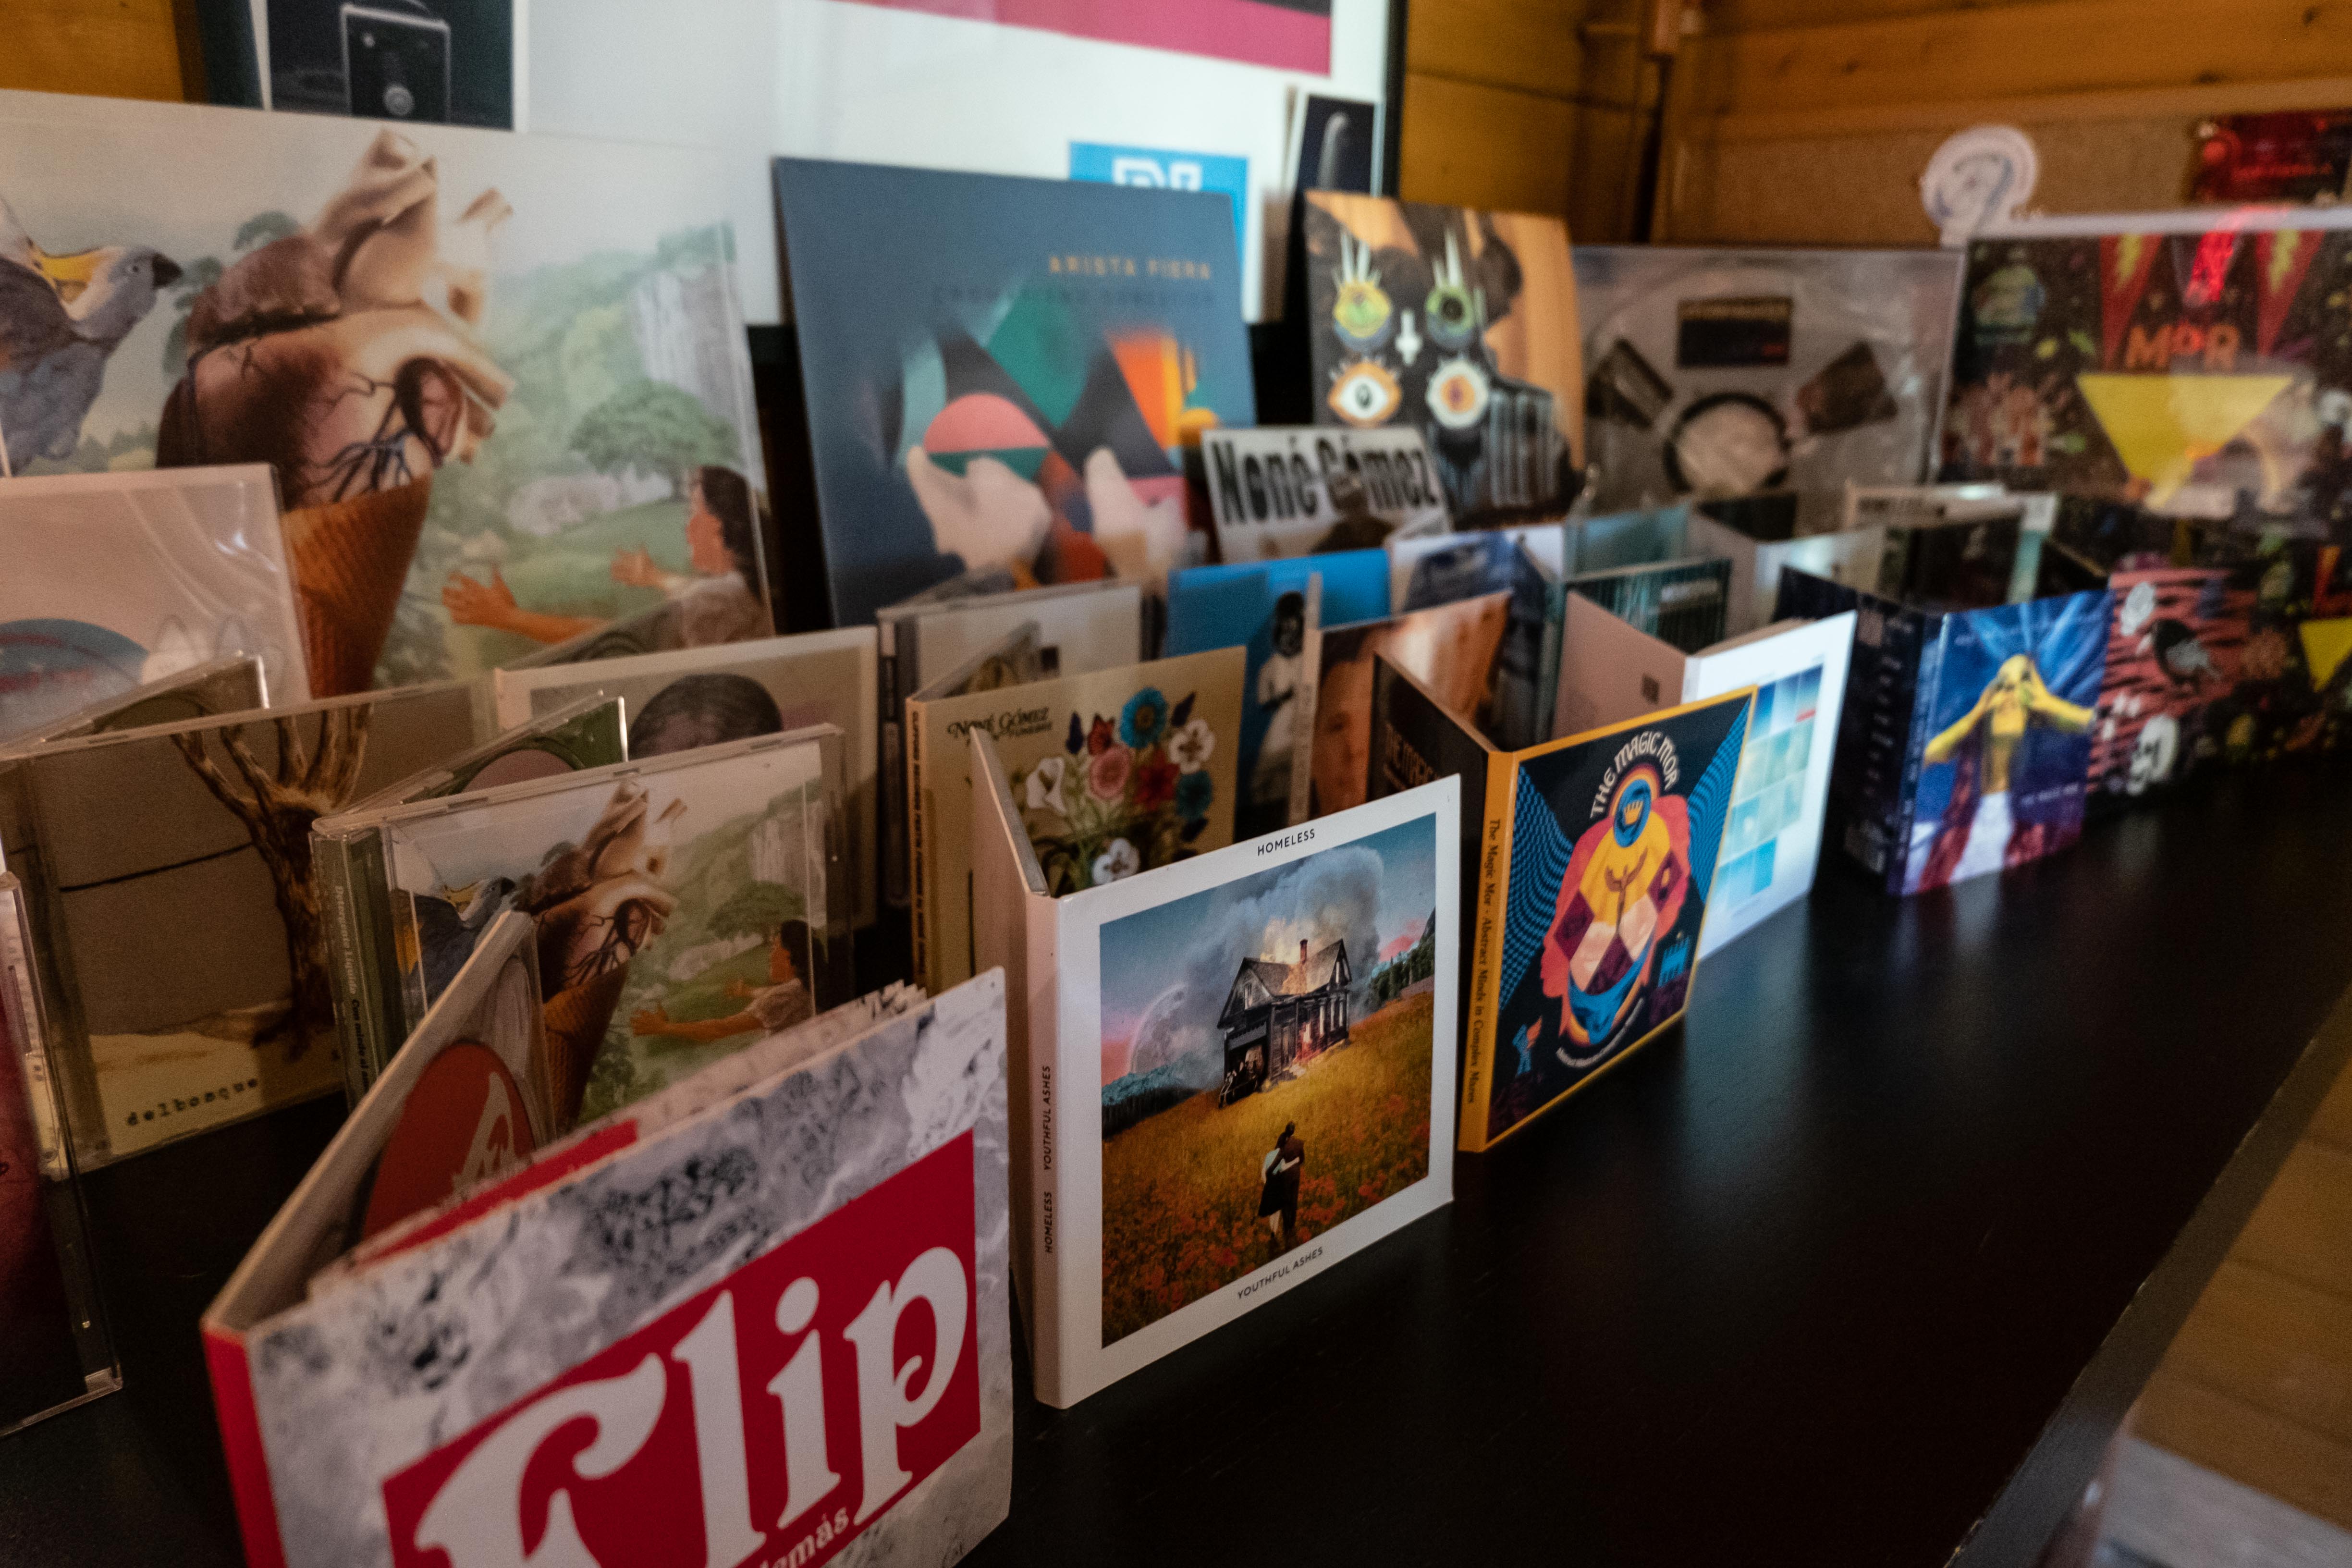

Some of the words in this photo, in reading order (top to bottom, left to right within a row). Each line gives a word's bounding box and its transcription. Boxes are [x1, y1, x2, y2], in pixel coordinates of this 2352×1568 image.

[1590, 766, 1617, 819] THE
[1614, 730, 1664, 773] MAGIC
[1656, 735, 1679, 791] MOR
[1257, 828, 1315, 857] HOMELESS
[1489, 818, 1500, 841] The
[1483, 845, 1498, 879] Magic
[1483, 882, 1495, 906] Mor
[1479, 916, 1492, 965] Abstract
[1475, 969, 1488, 1002] Minds
[1475, 1005, 1482, 1016] in
[1470, 1020, 1484, 1066] Complex
[1042, 1065, 1052, 1105] ASHES
[1043, 1108, 1052, 1171] YOUTHFUL
[1044, 1191, 1054, 1254] HOMELESS
[1237, 1266, 1290, 1299] YOUTHFUL
[1292, 1246, 1323, 1271] ASHES
